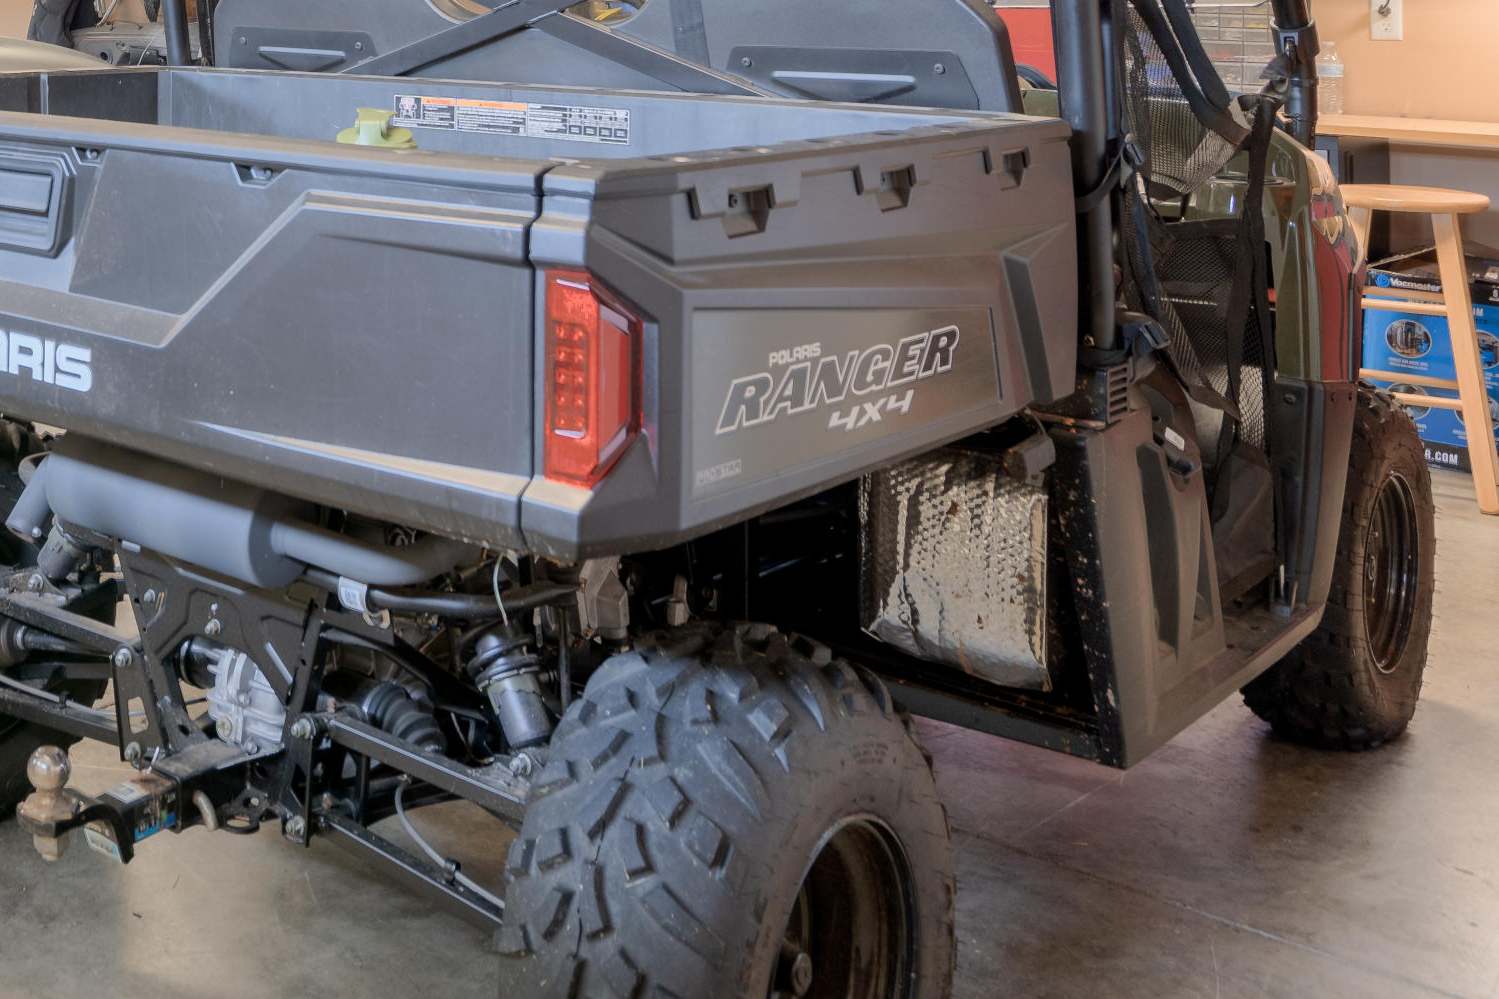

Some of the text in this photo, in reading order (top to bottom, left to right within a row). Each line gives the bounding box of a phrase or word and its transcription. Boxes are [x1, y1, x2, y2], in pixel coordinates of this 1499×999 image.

[1390, 277, 1442, 292] Vacmaster
[769, 342, 822, 367] POLARIS
[715, 324, 960, 435] RANGER
